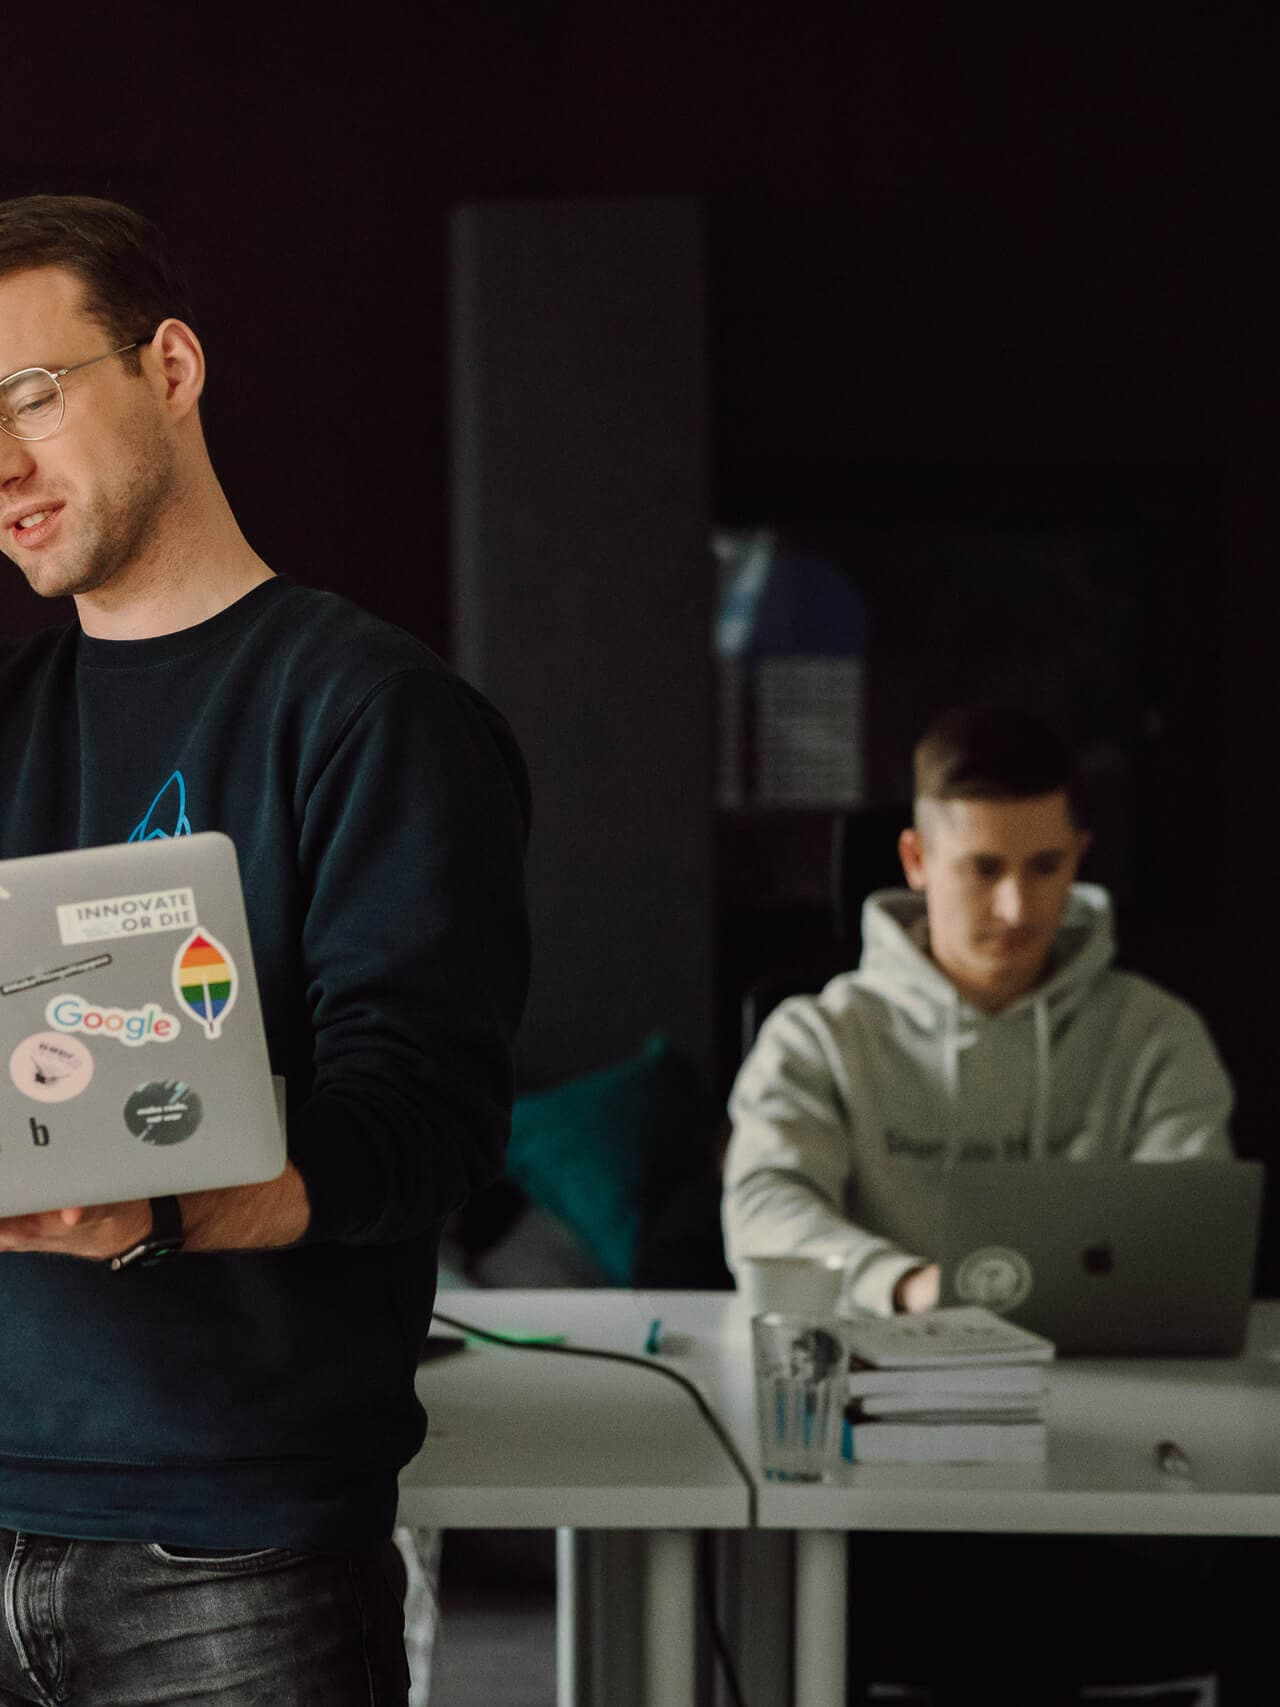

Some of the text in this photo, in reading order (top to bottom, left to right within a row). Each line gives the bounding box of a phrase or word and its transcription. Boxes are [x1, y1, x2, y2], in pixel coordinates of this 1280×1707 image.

[77, 893, 189, 921] INNOVATE
[122, 916, 153, 932] OR
[160, 911, 192, 927] DIE
[53, 1000, 172, 1040] Google
